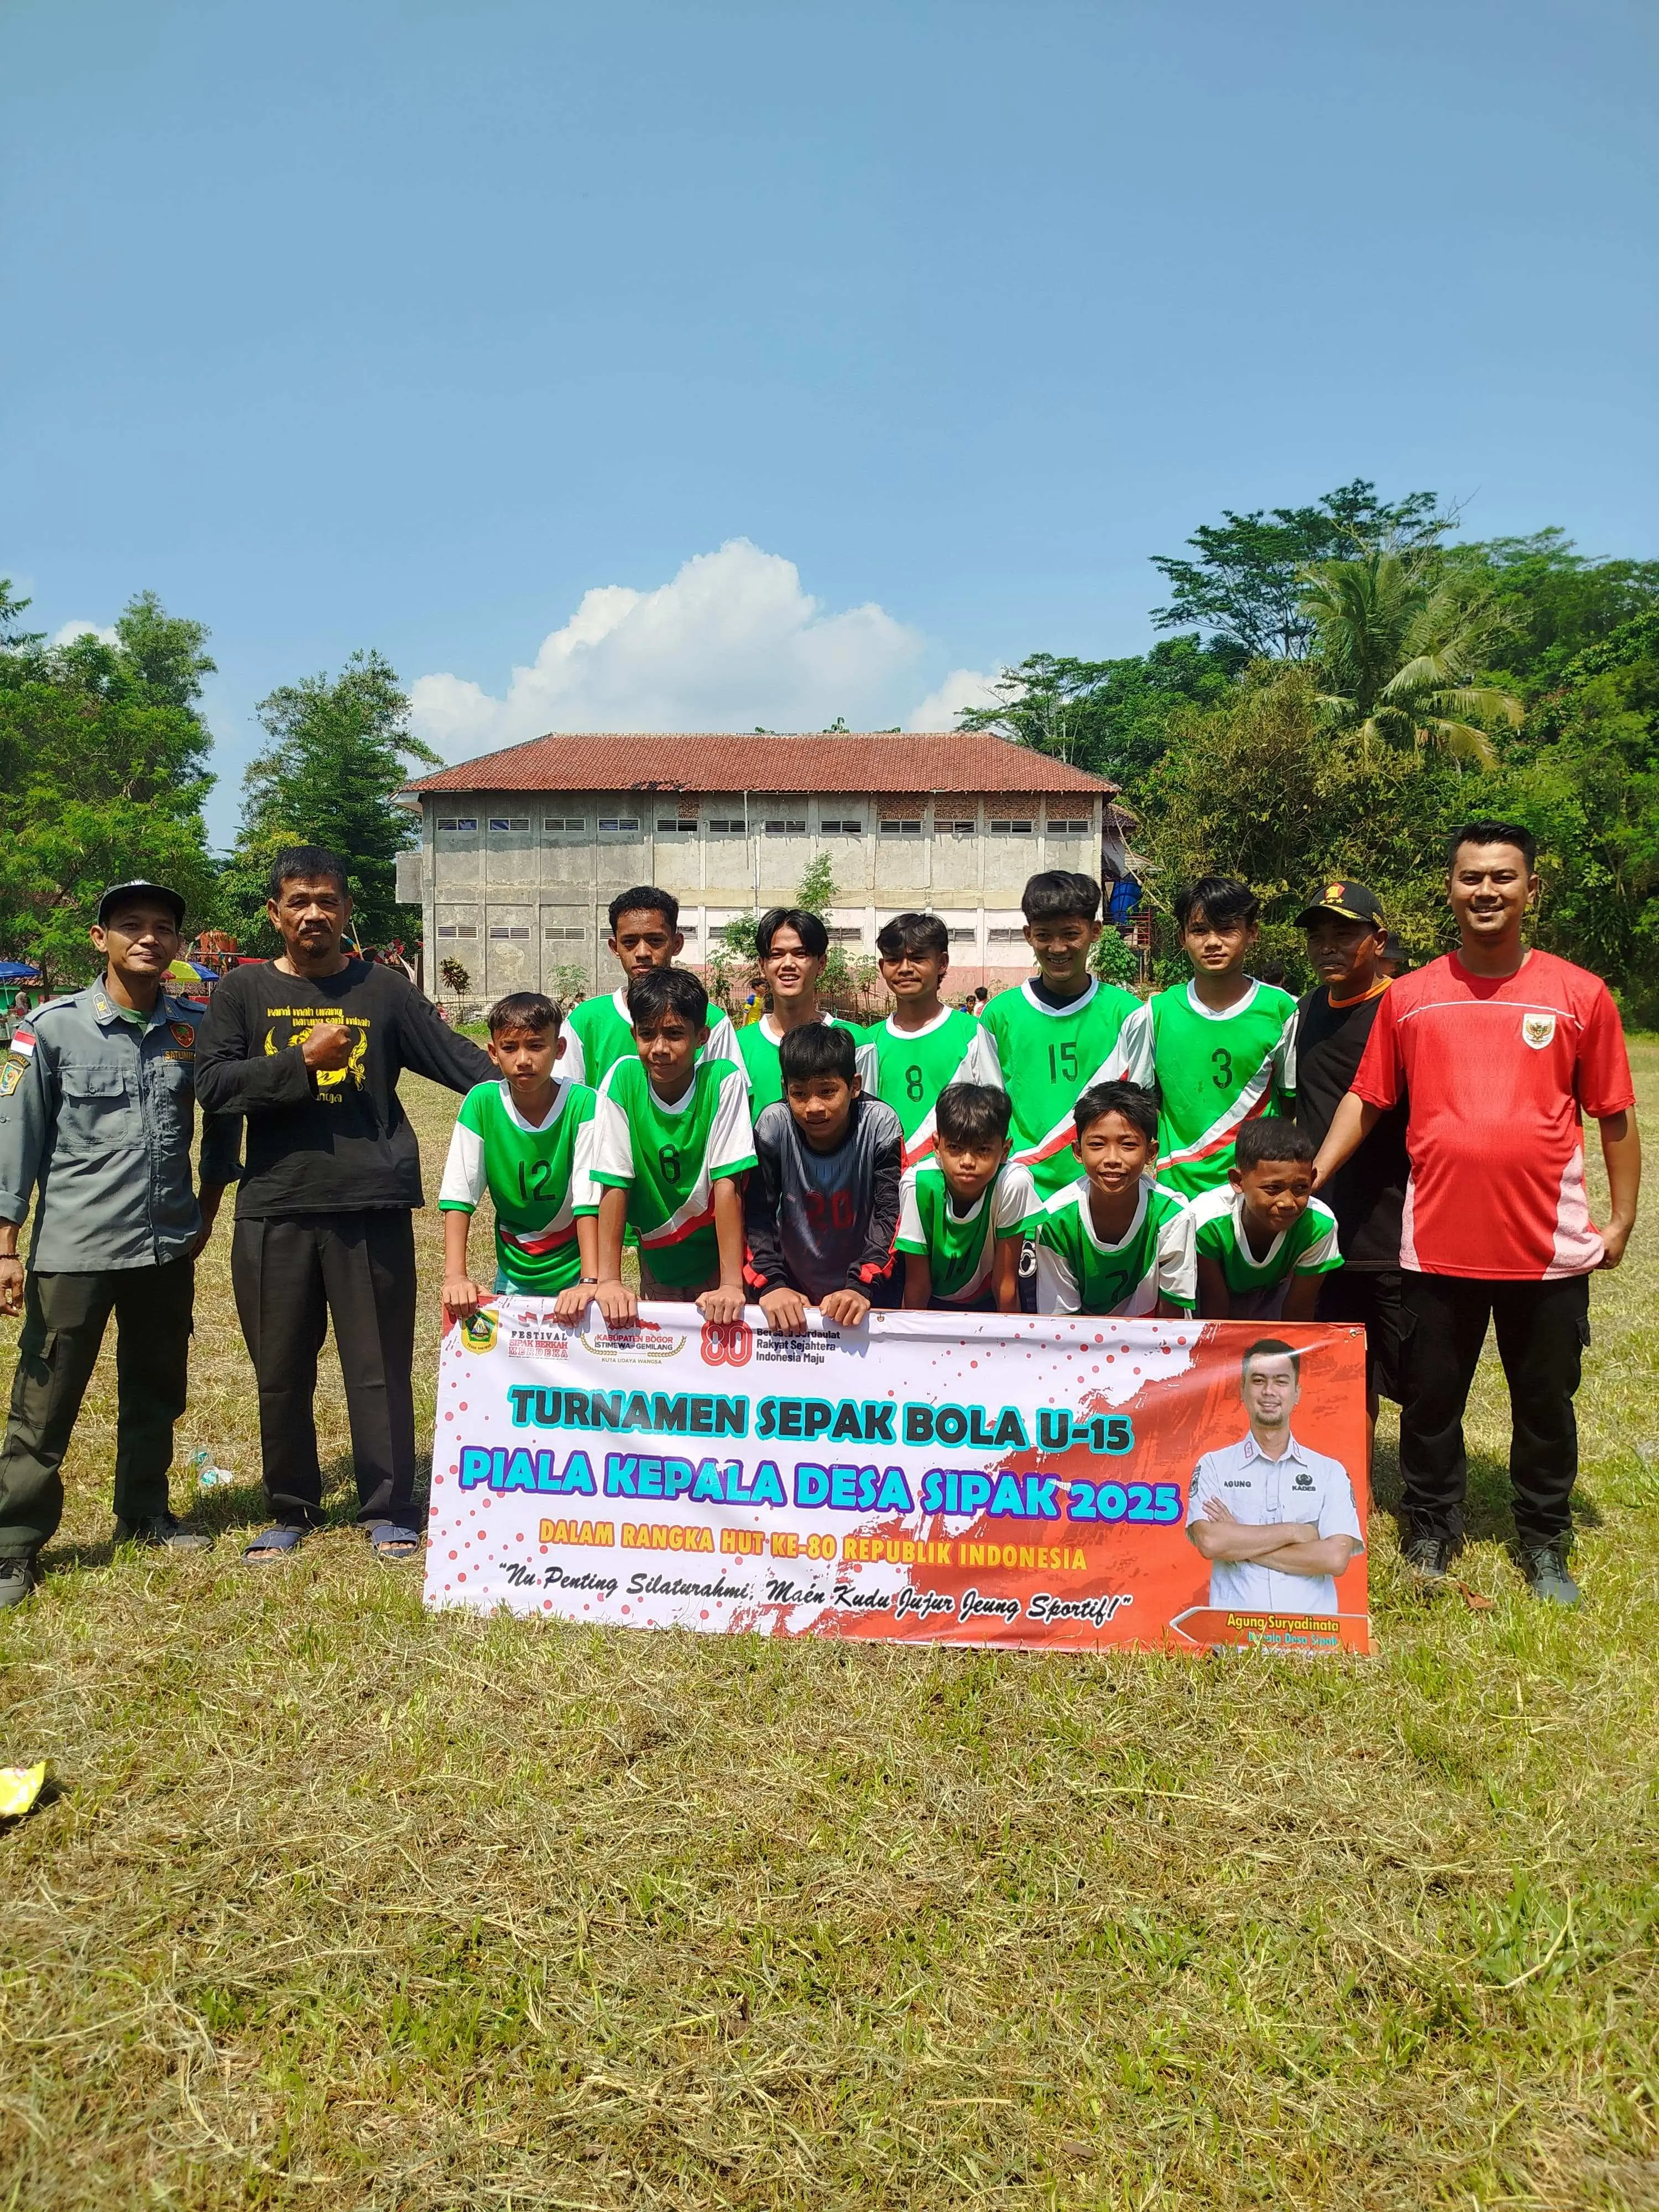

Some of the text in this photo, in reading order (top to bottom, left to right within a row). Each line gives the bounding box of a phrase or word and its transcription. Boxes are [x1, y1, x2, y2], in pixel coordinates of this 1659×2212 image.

[1048, 1041, 1078, 1084] 15
[1211, 1048, 1233, 1089] 3
[905, 1065, 924, 1102] 8
[518, 1160, 556, 1201] 12
[659, 1143, 681, 1184] 6
[1105, 1269, 1129, 1303] 7
[508, 1347, 568, 1358] MERDEKA
[511, 1331, 568, 1340] FESTIVAL
[535, 1340, 568, 1349] BERKAH
[596, 1334, 643, 1343] KABUPATEN
[700, 1318, 753, 1368] 80
[757, 1339, 836, 1352] Rakyat Sejahtera
[756, 1352, 825, 1365] Indonesia Maju
[510, 1386, 1132, 1452] TURNAMEN SEPAK BOLA U-15
[460, 1448, 1182, 1522] PIALA KEPALA DESA SIPAK 2025
[1224, 1480, 1252, 1488] AGUNG
[540, 1519, 1088, 1571] DALAM RANGKA HUT KE-80 REPUBLIK INDONESIA
[544, 1566, 619, 1598] Penting
[766, 1579, 826, 1605] Maén
[833, 1585, 890, 1609] Kudu
[896, 1588, 954, 1618] Jujur
[959, 1589, 1020, 1621] Jeung
[1227, 1613, 1339, 1632] Agung Suryadinata
[1284, 1632, 1307, 1645] Desa
